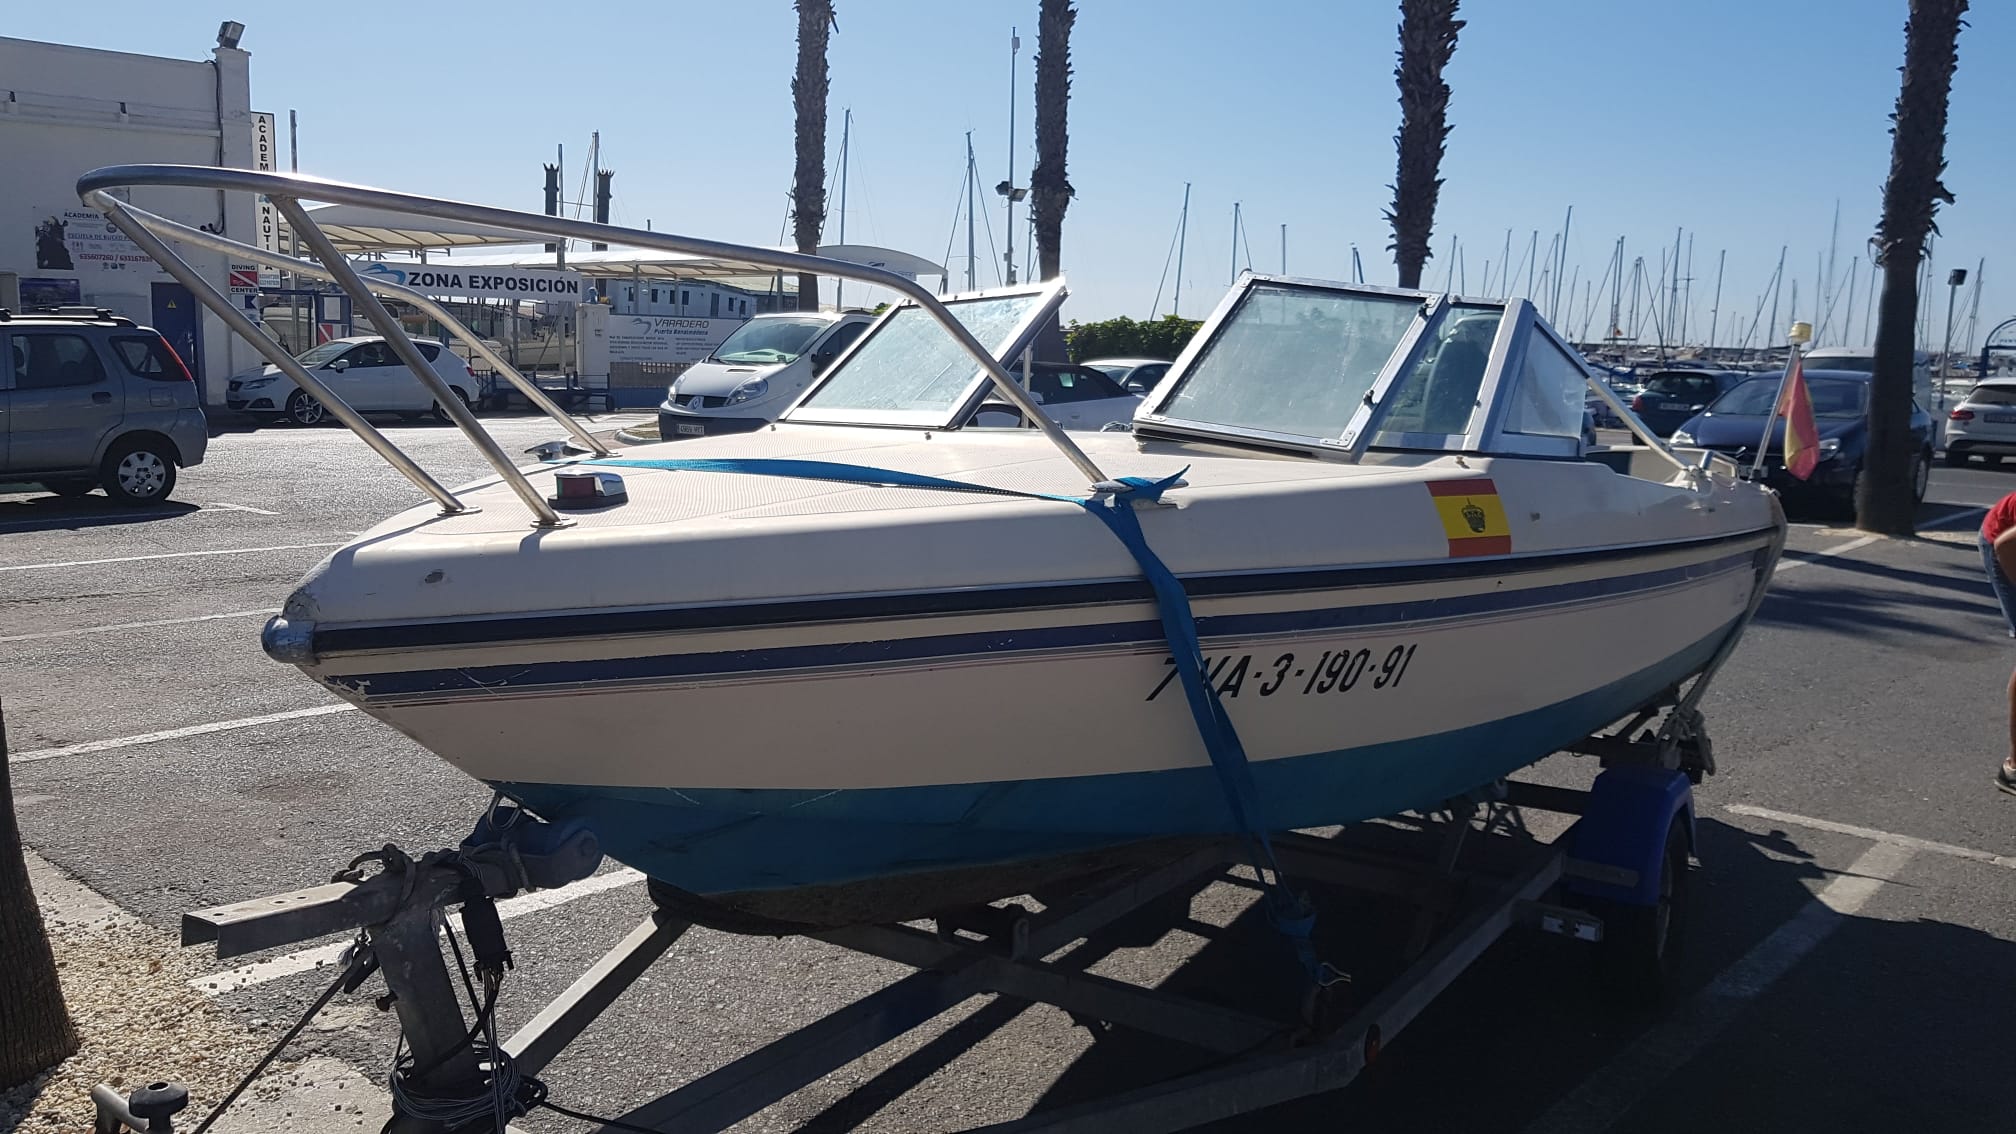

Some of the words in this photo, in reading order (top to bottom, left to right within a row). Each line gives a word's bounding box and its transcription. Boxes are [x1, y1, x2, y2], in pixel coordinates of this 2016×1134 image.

[64, 212, 99, 220] ACADEMIA
[262, 206, 273, 270] NAUTIA
[408, 272, 463, 289] ZONA
[468, 275, 579, 294] EXPOSICIÓN
[654, 318, 710, 329] VARADERO
